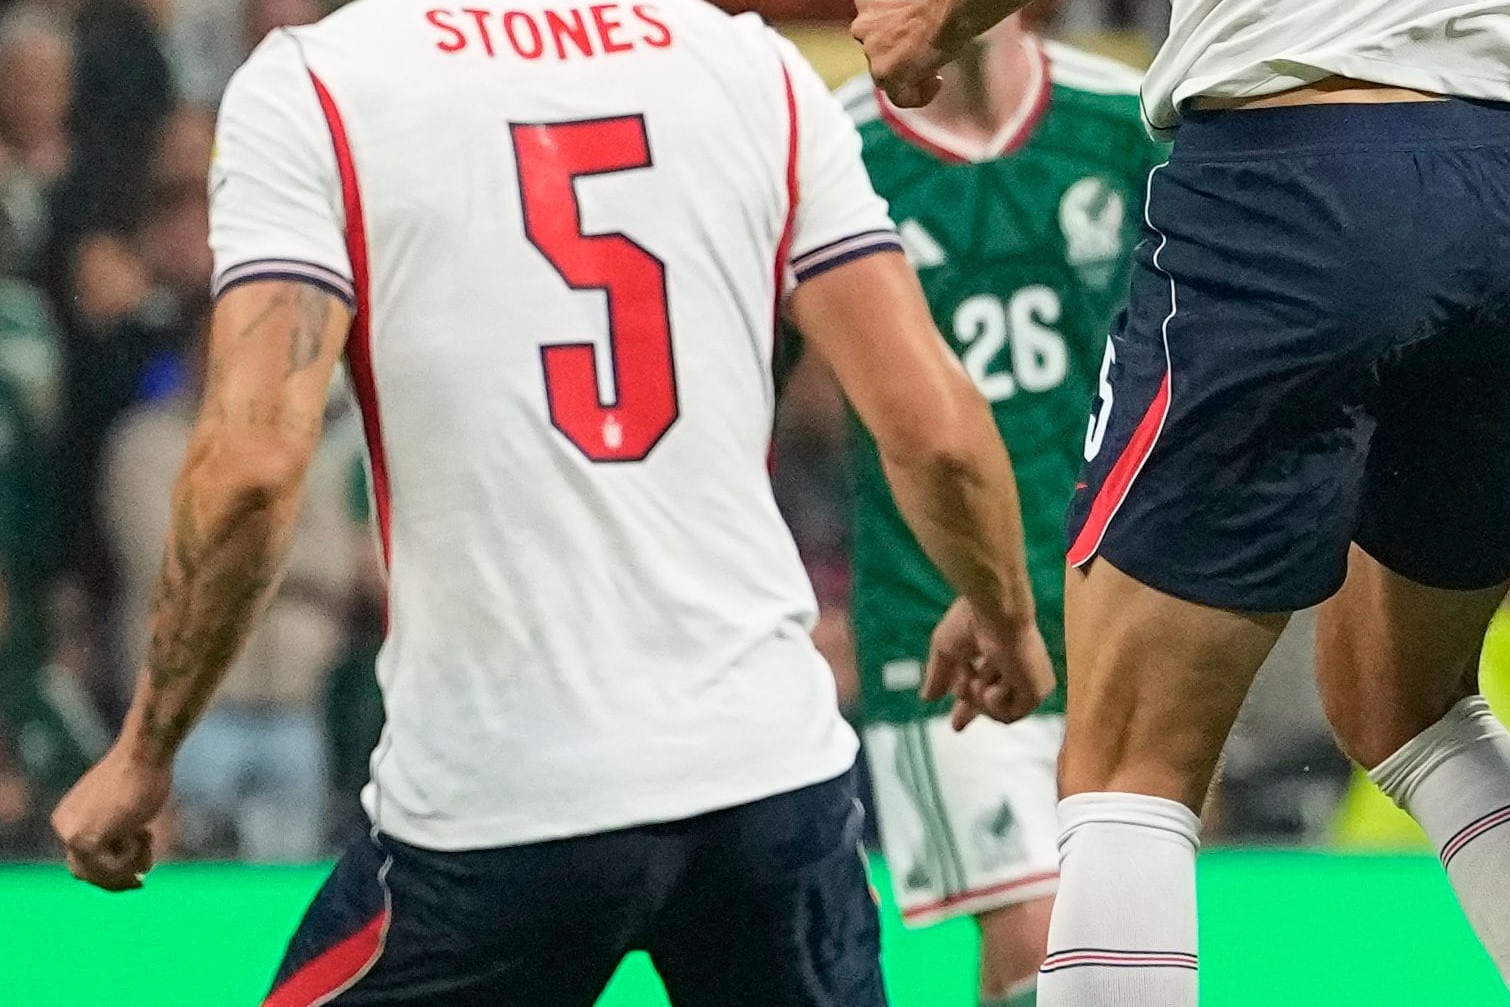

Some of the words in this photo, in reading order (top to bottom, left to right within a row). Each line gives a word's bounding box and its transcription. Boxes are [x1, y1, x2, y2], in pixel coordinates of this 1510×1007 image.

[425, 4, 672, 60] STONES
[508, 113, 679, 462] 5
[952, 282, 1069, 402] 26
